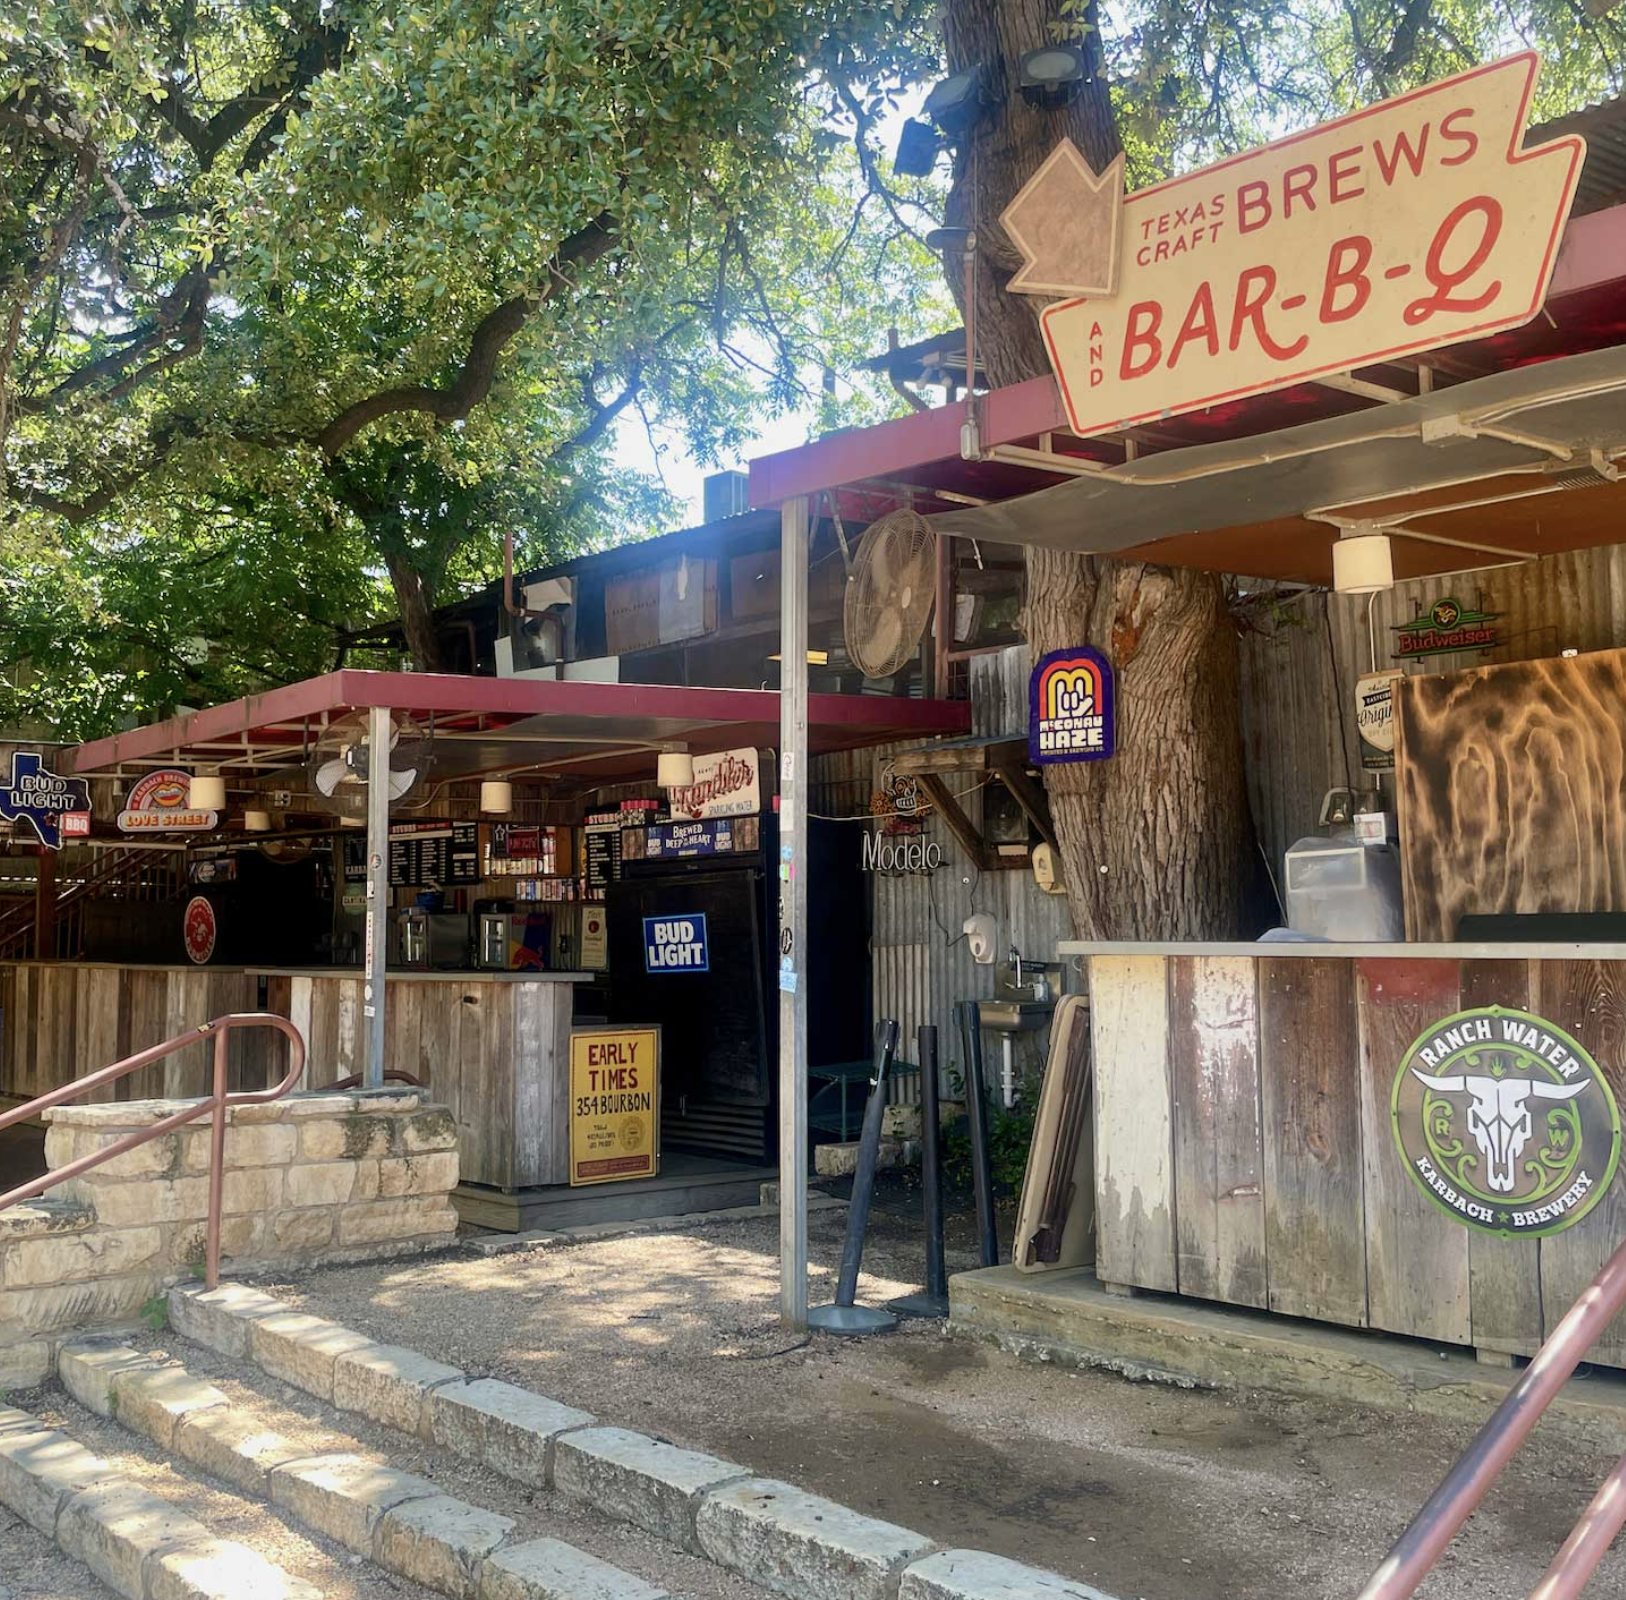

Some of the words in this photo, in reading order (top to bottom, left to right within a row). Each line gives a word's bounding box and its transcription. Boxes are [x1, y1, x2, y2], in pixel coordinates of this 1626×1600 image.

[1236, 108, 1479, 235] BREWS
[1141, 194, 1226, 240] TEXAS
[1136, 221, 1225, 267] CRAFT
[1119, 195, 1503, 381] BAR-B-Q
[1088, 320, 1103, 388] AND
[1399, 627, 1496, 652] Budweiser
[1039, 727, 1104, 750] HAZE
[20, 774, 67, 793] BUD
[10, 791, 77, 810] LIGHT
[65, 817, 88, 833] BBQ
[126, 815, 159, 827] LOVE
[163, 813, 209, 826] STREET
[673, 823, 703, 839] BREWED
[665, 838, 684, 850] DEEP
[688, 834, 712, 847] HEART
[861, 829, 941, 871] Modelo
[653, 920, 694, 945] BUD
[648, 942, 704, 968] LIGHT
[588, 1042, 639, 1066] EARLY
[1418, 1019, 1493, 1068] RANCH
[1501, 1019, 1580, 1078] WATER
[588, 1068, 639, 1092] TIMES
[576, 1096, 599, 1117] 354
[601, 1092, 651, 1115] BOURBON
[1434, 1118, 1450, 1135] R
[1548, 1128, 1569, 1148] W
[1415, 1156, 1494, 1223] KARBACH
[1511, 1170, 1594, 1227] BREWERY
